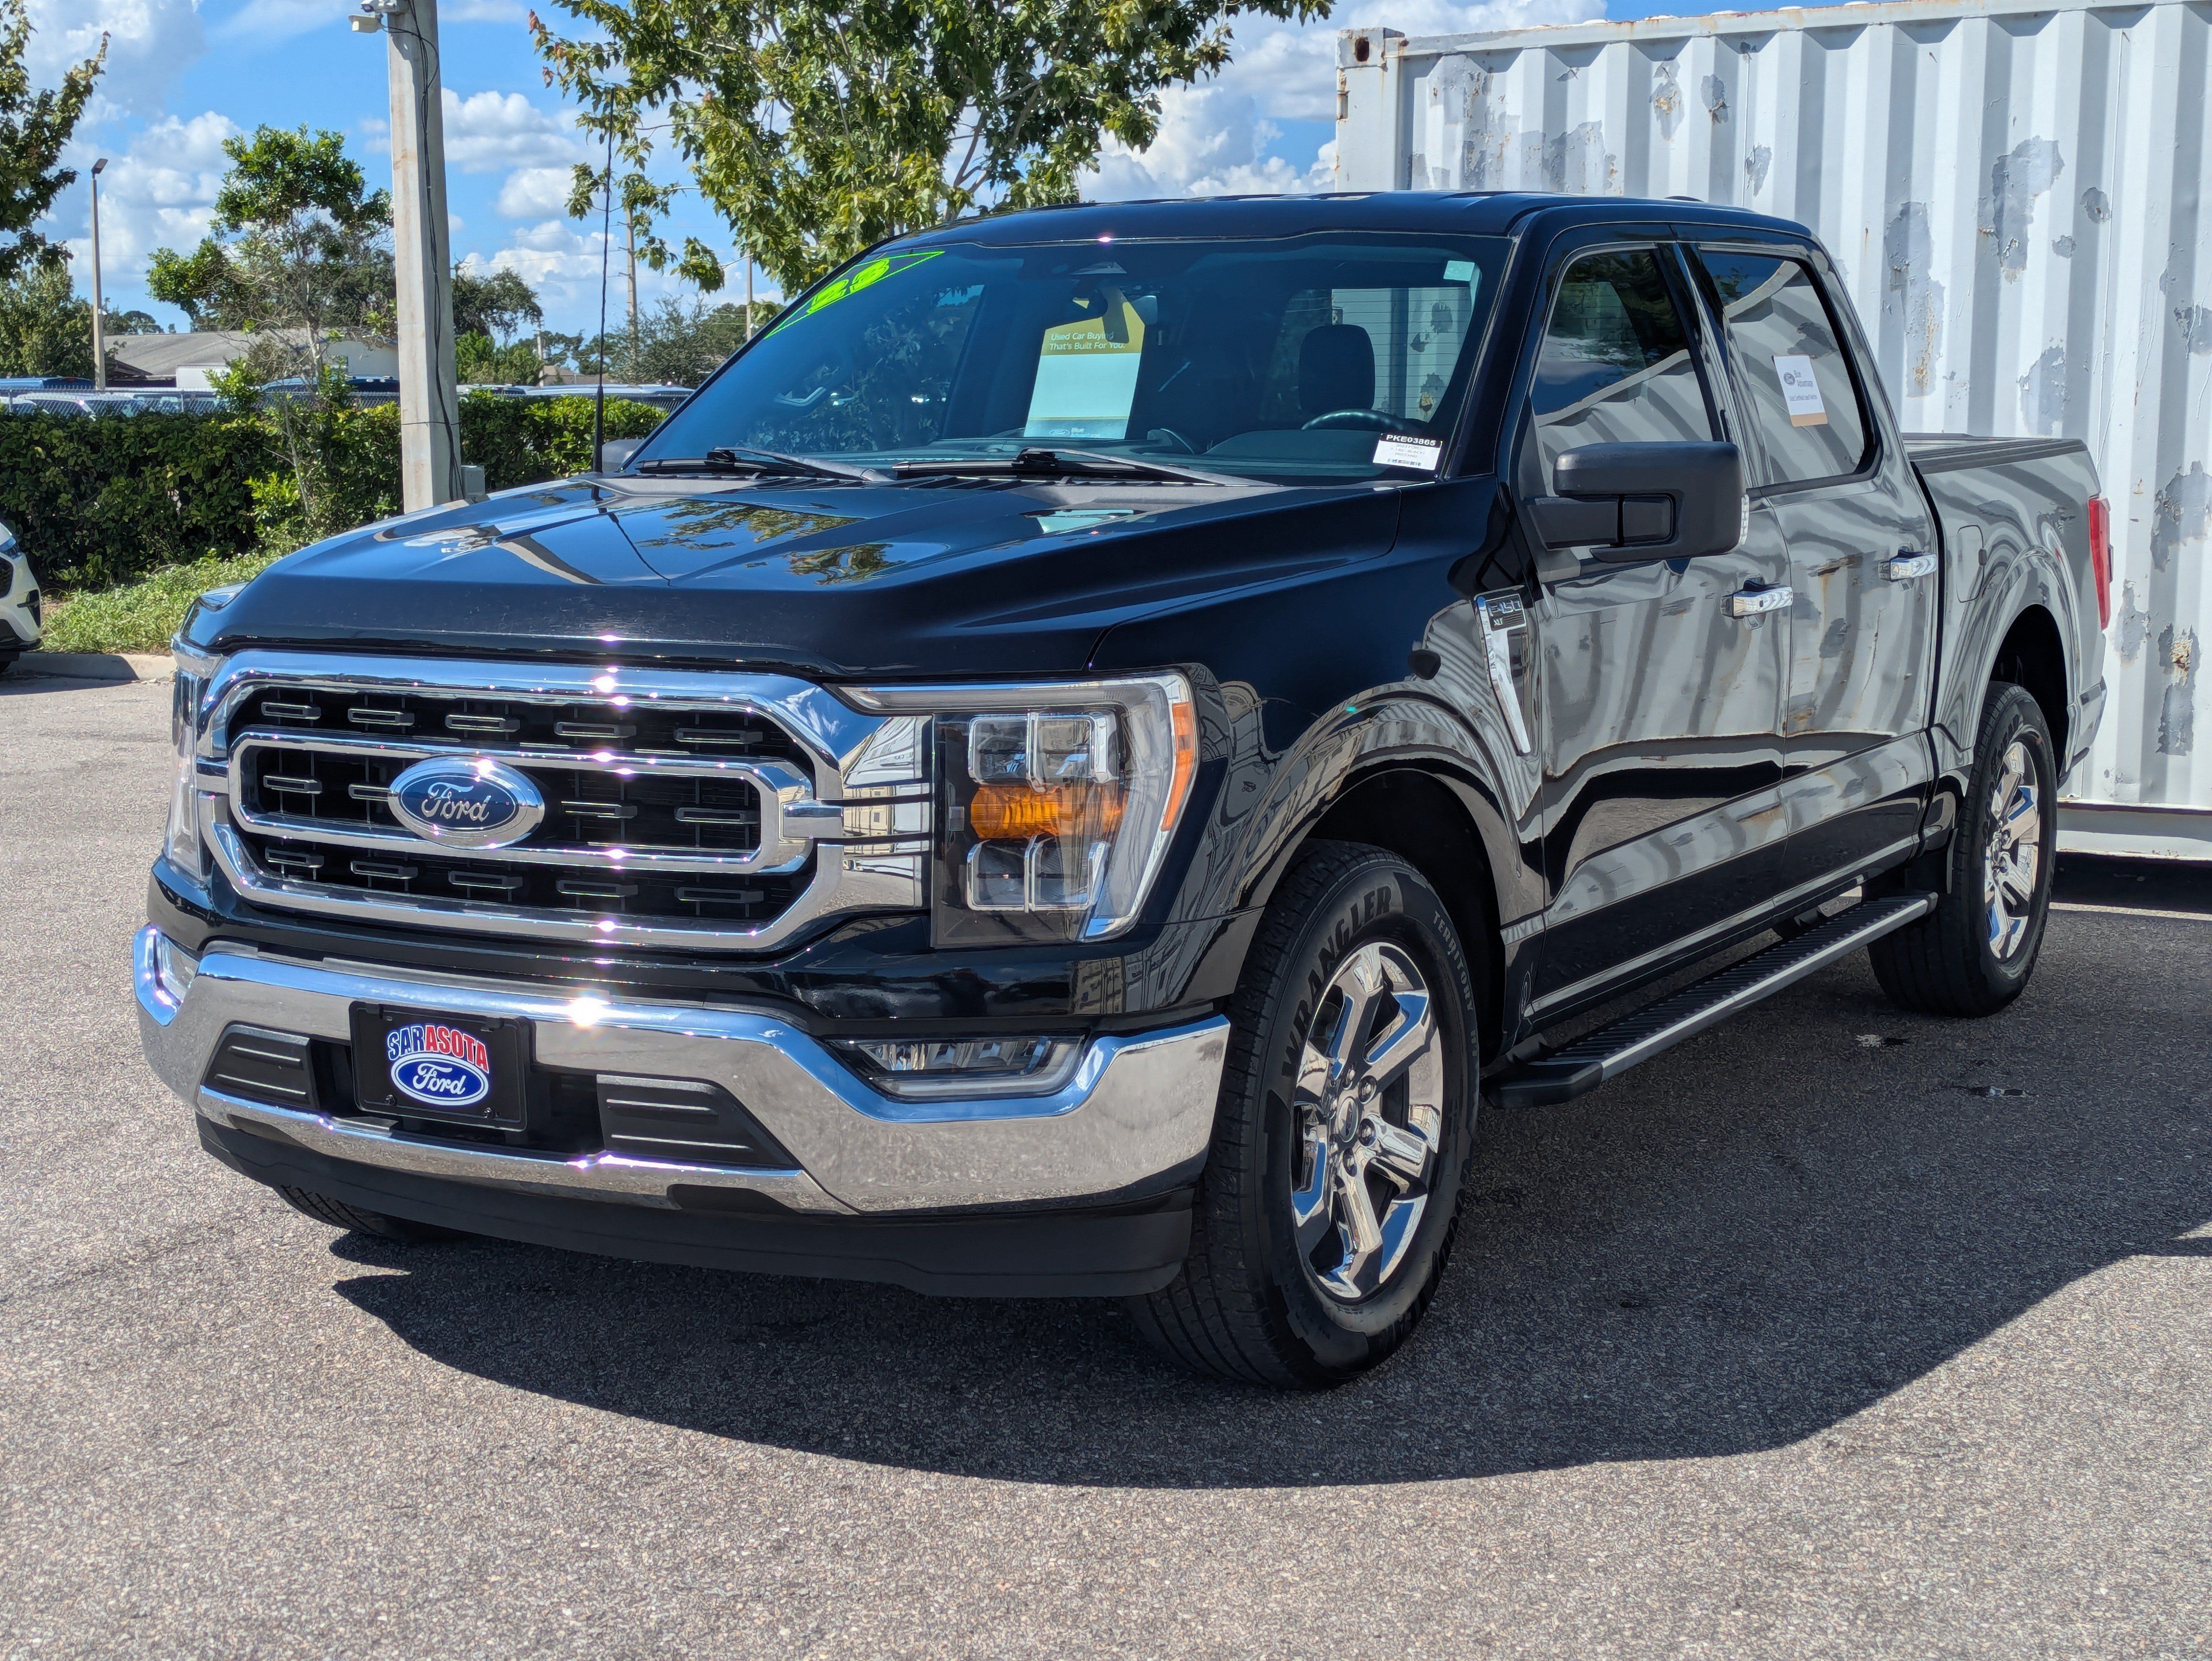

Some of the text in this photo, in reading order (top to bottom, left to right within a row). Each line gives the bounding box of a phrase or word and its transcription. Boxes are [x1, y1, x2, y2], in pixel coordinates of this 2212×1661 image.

[1050, 343, 1072, 351] That's
[1051, 332, 1071, 341] Used
[421, 782, 492, 822] Ford
[1432, 910, 1474, 1011] TERRITORY
[1281, 886, 1392, 1077] WRANGLER
[387, 1025, 489, 1074] SARASOTA
[412, 1063, 466, 1095] Ford
